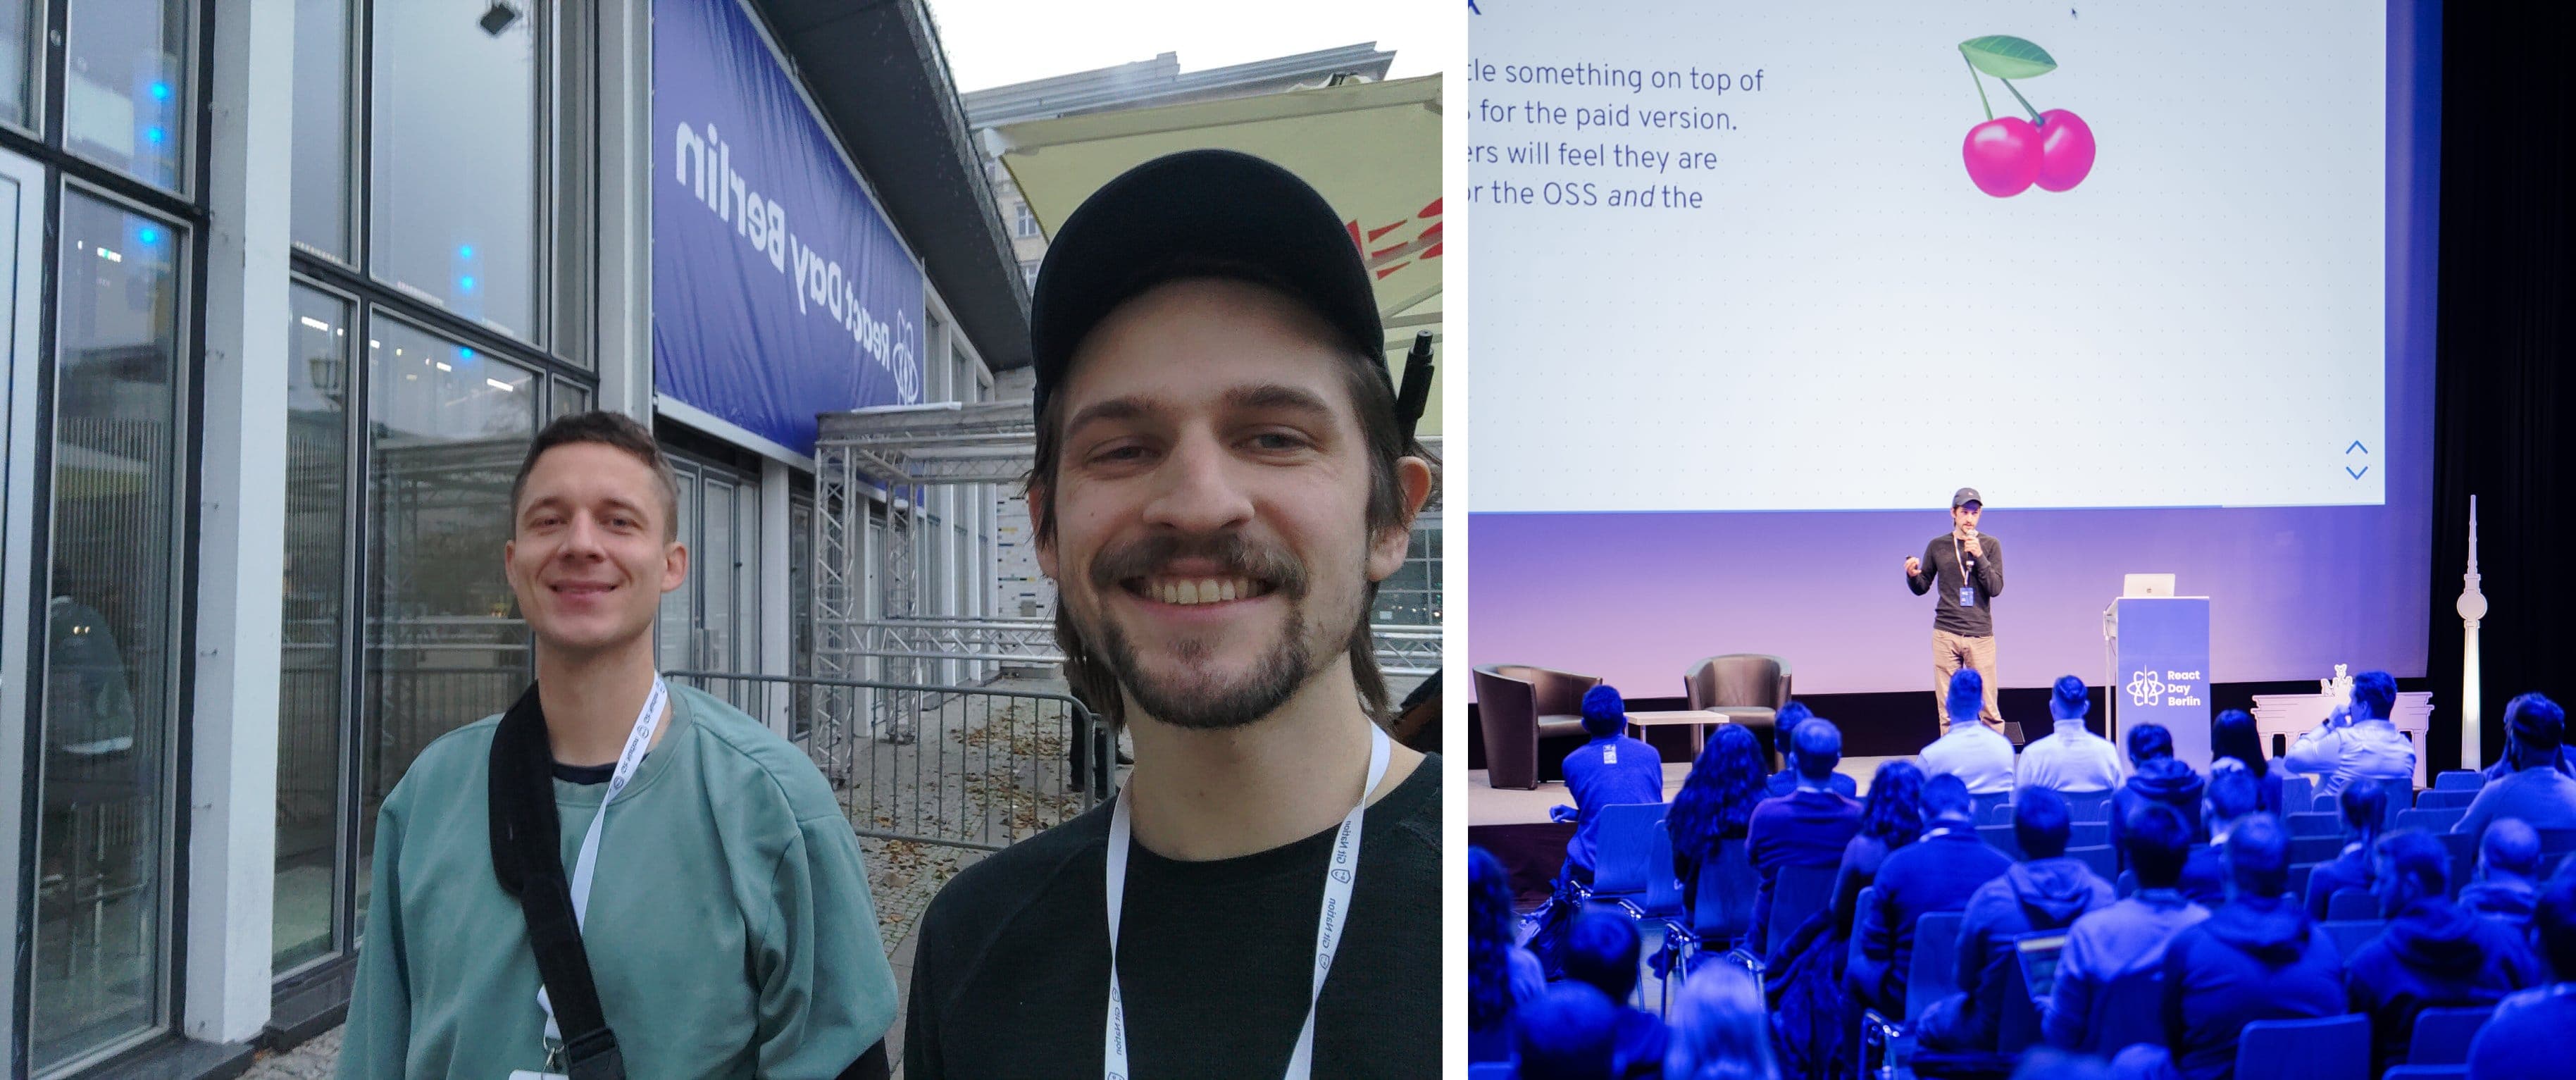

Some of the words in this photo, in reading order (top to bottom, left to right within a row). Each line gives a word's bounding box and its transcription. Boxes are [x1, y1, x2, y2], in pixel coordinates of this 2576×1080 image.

[1506, 62, 1641, 94] something
[1652, 71, 1681, 89] on
[1690, 67, 1731, 96] top
[1740, 69, 1764, 91] of
[1480, 99, 1516, 123] for
[1524, 101, 1567, 125] the
[1577, 104, 1629, 130] paid
[1639, 106, 1736, 130] version.
[1507, 142, 1548, 164] will
[1558, 142, 1603, 166] feel
[1613, 144, 1669, 174] they
[1679, 152, 1717, 169] are
[1491, 180, 1533, 204] the
[1543, 182, 1597, 206] OSS
[1608, 185, 1655, 207] and
[1662, 185, 1703, 209] the
[2167, 670, 2201, 681] React
[2167, 683, 2191, 696] Day
[2167, 695, 2201, 707] Berlin
